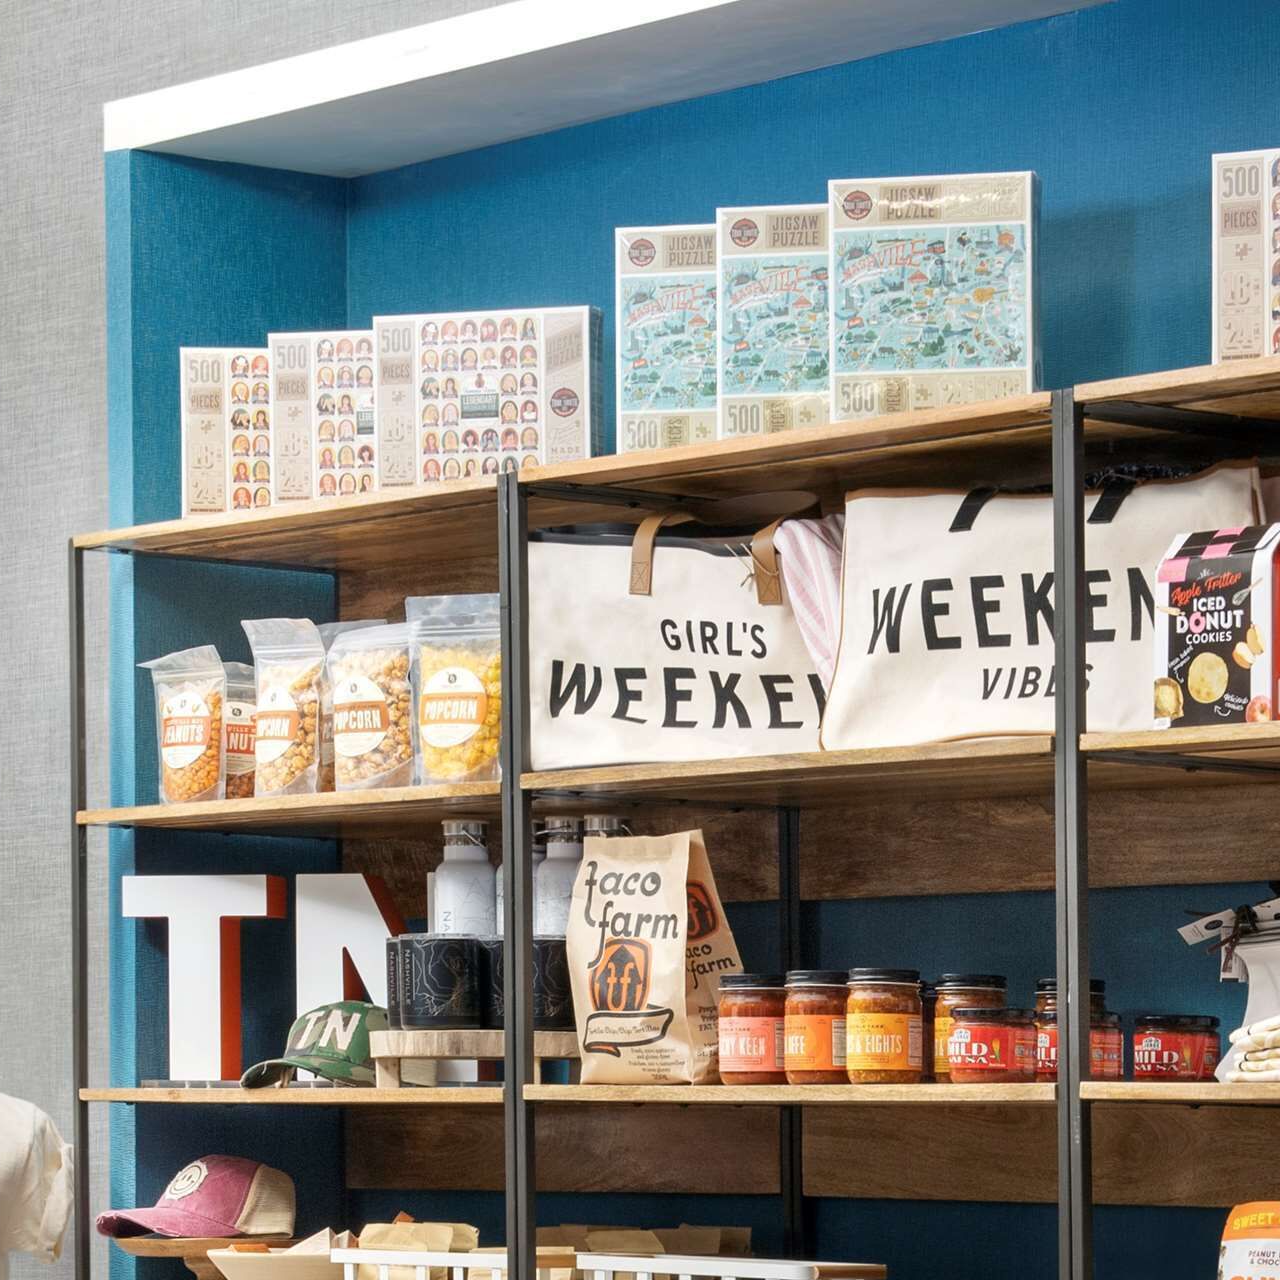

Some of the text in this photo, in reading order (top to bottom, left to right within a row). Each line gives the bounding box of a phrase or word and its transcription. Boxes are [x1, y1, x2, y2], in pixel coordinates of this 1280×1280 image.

[1222, 166, 1259, 198] 500
[772, 217, 818, 232] JIGSAW
[1223, 209, 1258, 230] PIECES
[668, 235, 713, 253] JIGSAW
[771, 232, 820, 247] PUZZLE
[667, 251, 713, 267] PUZZLE
[381, 327, 412, 353] 500
[276, 344, 307, 369] 500
[189, 359, 220, 384] 500
[382, 362, 410, 380] PIECES
[279, 378, 306, 398] PIECES
[728, 405, 759, 433] 500
[627, 420, 657, 448] 500
[1171, 571, 1241, 607] Apple Fritter
[1193, 597, 1226, 612] ICED
[1176, 610, 1244, 634] DONUT
[660, 618, 768, 660] GIRL'S
[1186, 631, 1232, 645] COOKIES
[585, 861, 662, 927] taco
[587, 901, 679, 968] farm
[298, 1012, 365, 1050] TN
[865, 1035, 902, 1054] EIGHTS
[949, 1042, 988, 1056] MILD
[1134, 1051, 1178, 1064] MILD
[1233, 1213, 1275, 1231] SWEET
